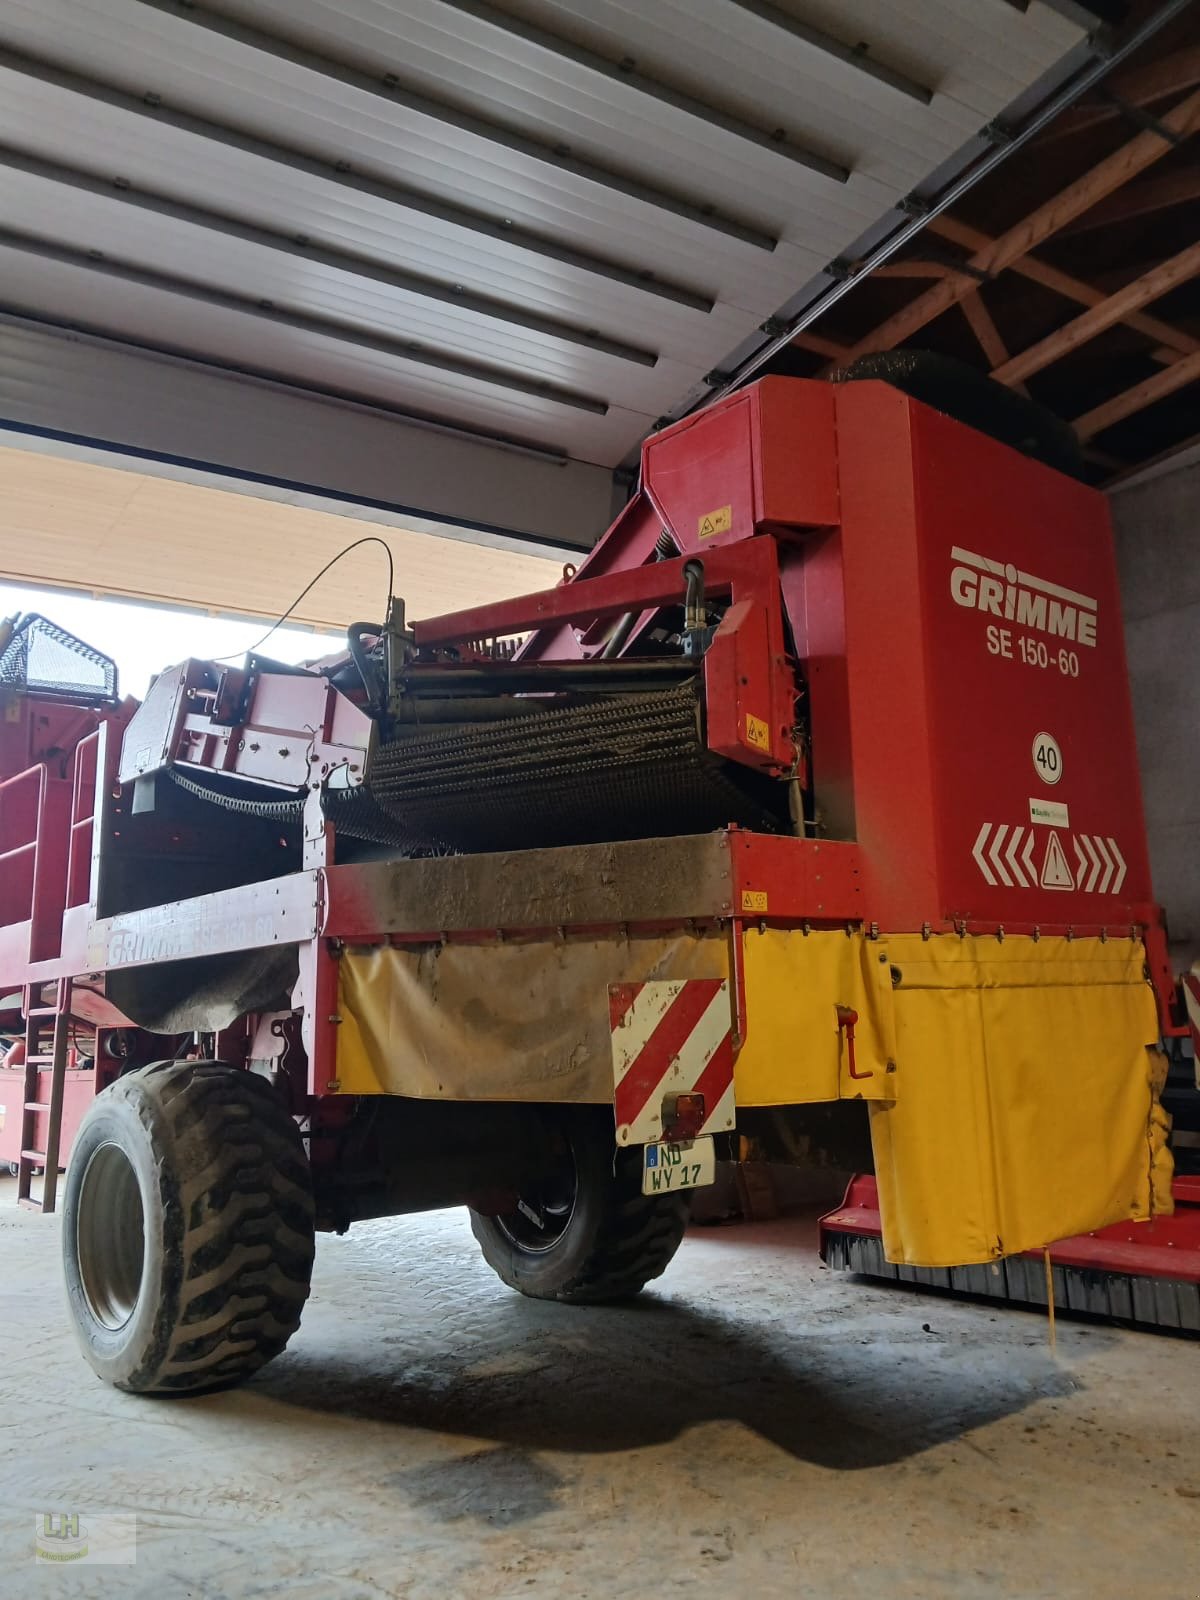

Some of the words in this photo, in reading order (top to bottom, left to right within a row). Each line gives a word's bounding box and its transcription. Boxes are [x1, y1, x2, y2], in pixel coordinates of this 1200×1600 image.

[951, 563, 1098, 647] GRIMME
[986, 625, 1013, 659] SE
[1018, 635, 1079, 678] 150-60
[1037, 745, 1057, 771] 40
[660, 1144, 682, 1167] ND
[652, 1167, 673, 1191] WY
[680, 1164, 702, 1186] 17
